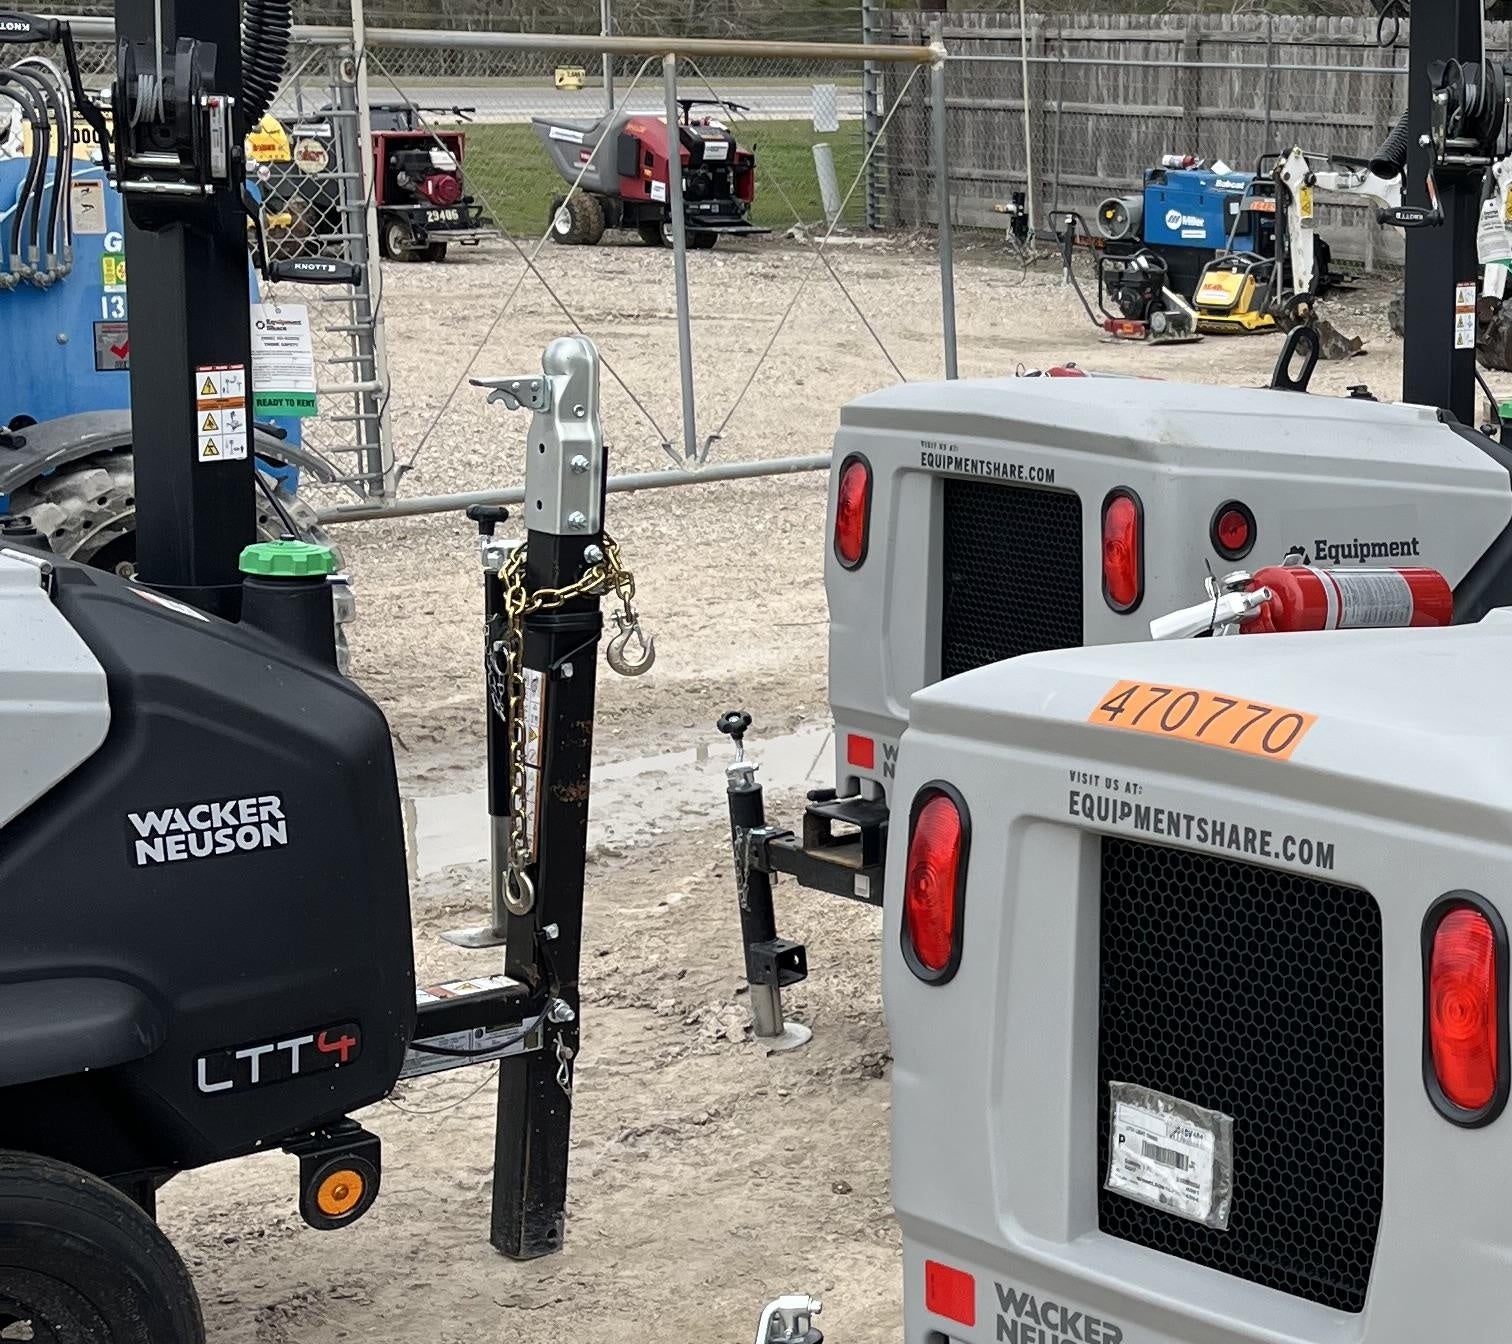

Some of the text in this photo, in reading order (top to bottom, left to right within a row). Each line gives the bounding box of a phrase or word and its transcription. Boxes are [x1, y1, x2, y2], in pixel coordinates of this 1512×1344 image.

[920, 452, 1055, 483] EQUIPMENTSHARE.COM
[1314, 537, 1420, 565] Equipment
[1100, 685, 1304, 754] 470770
[1069, 770, 1100, 789] VISIT
[1105, 777, 1119, 791] US
[128, 794, 284, 839] WACKER
[1069, 790, 1335, 870] EQUIPMENTSHARE.COM
[135, 820, 289, 866] NEUSON
